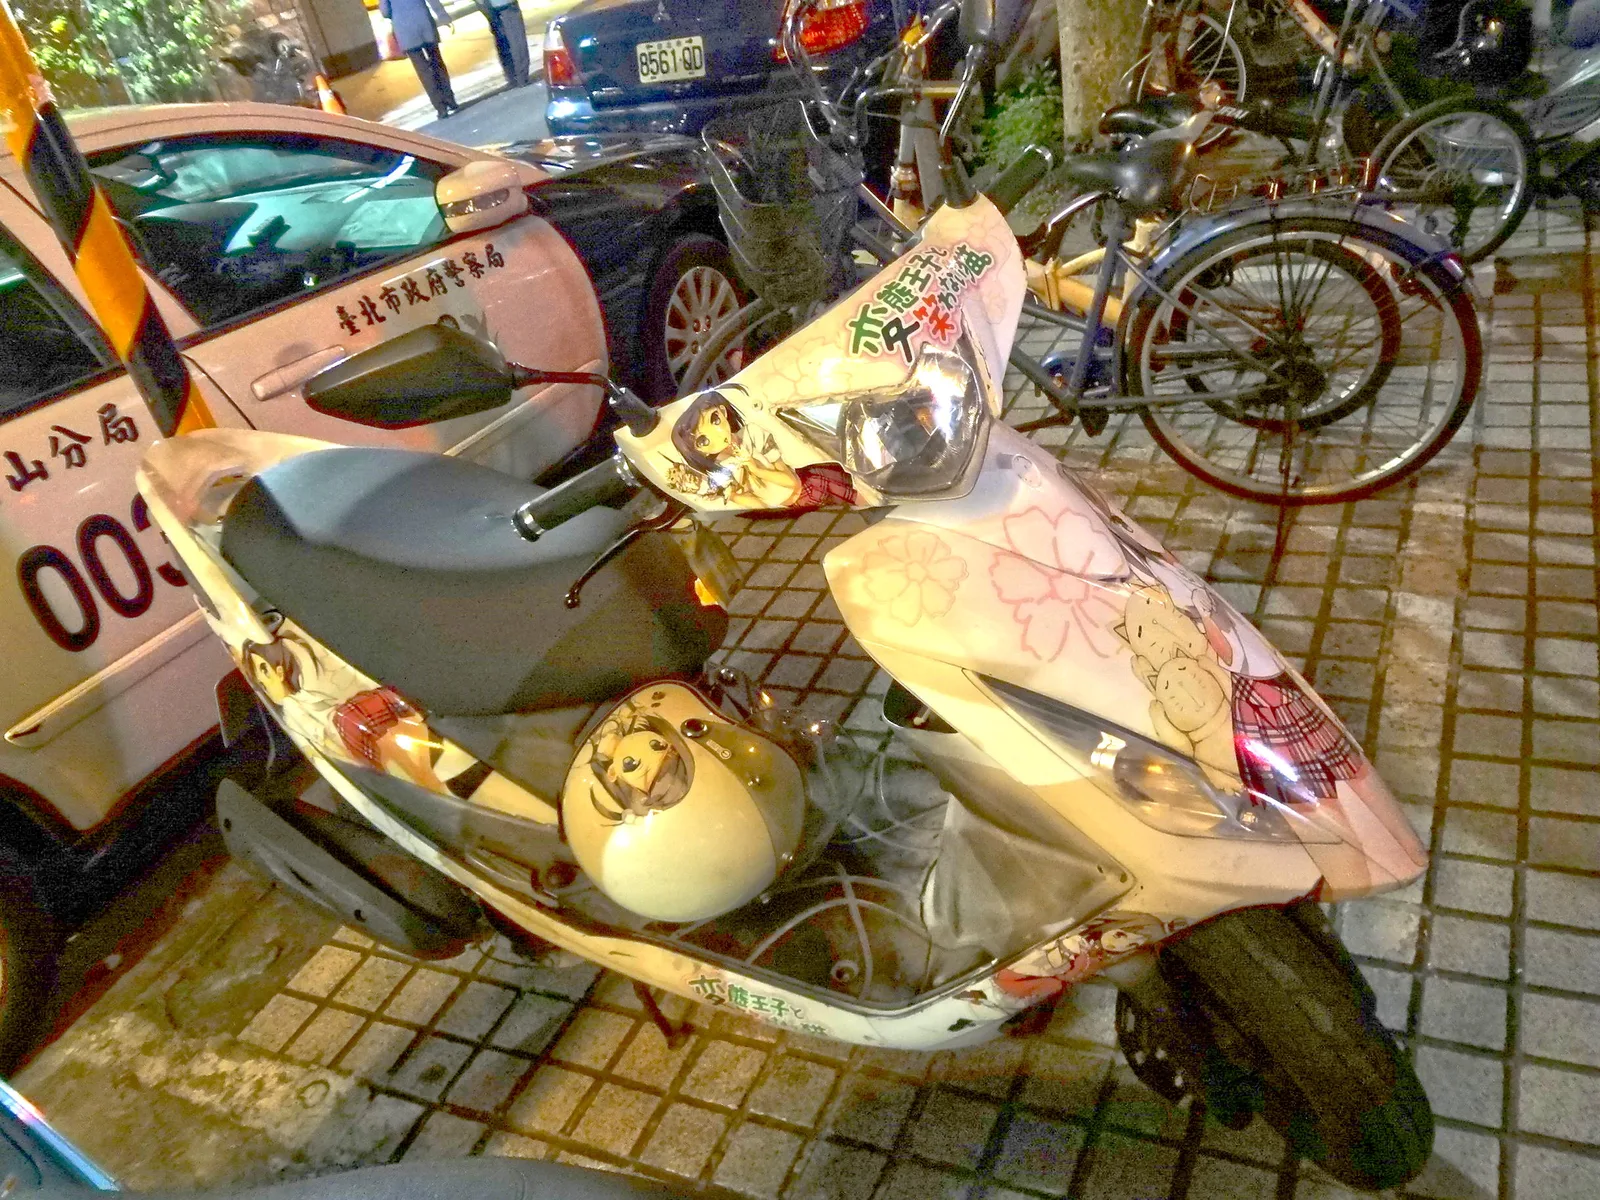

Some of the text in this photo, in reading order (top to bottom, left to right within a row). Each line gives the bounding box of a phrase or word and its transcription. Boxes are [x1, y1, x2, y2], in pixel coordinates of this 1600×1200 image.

[336, 243, 505, 336] 臺北市政府警察局
[3, 403, 139, 492] 山分局
